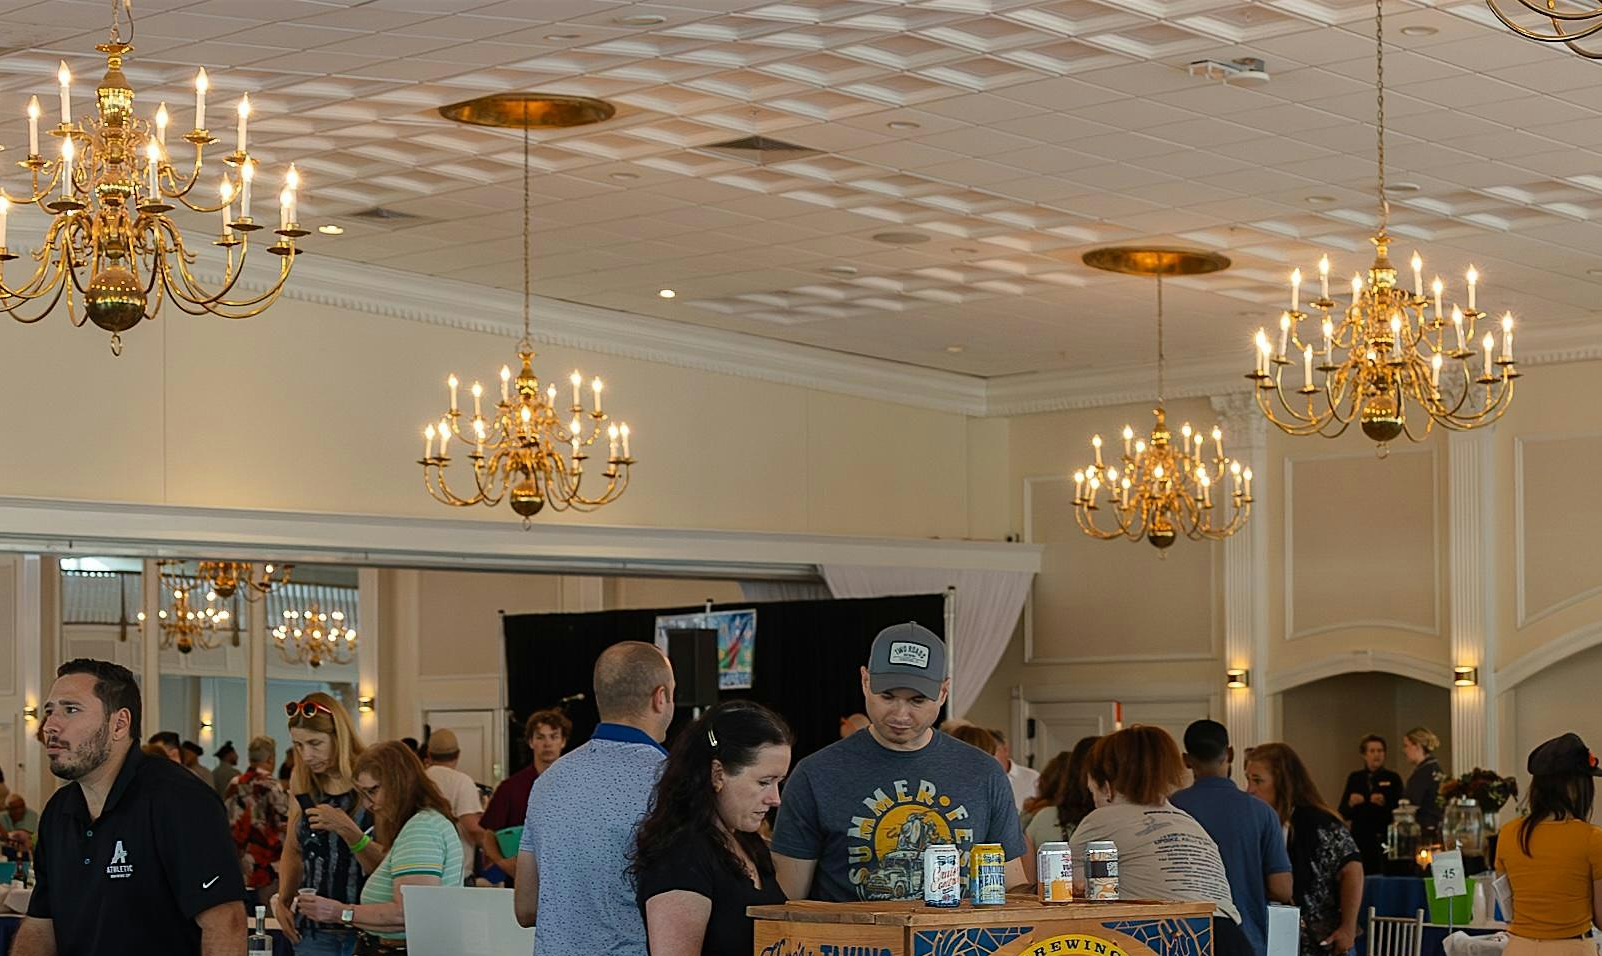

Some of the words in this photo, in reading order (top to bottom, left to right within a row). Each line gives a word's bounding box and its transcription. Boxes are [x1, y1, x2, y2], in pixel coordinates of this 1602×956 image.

[847, 779, 937, 885] SUMMER
[107, 865, 133, 873] ATHLETIC
[1442, 868, 1456, 879] 45
